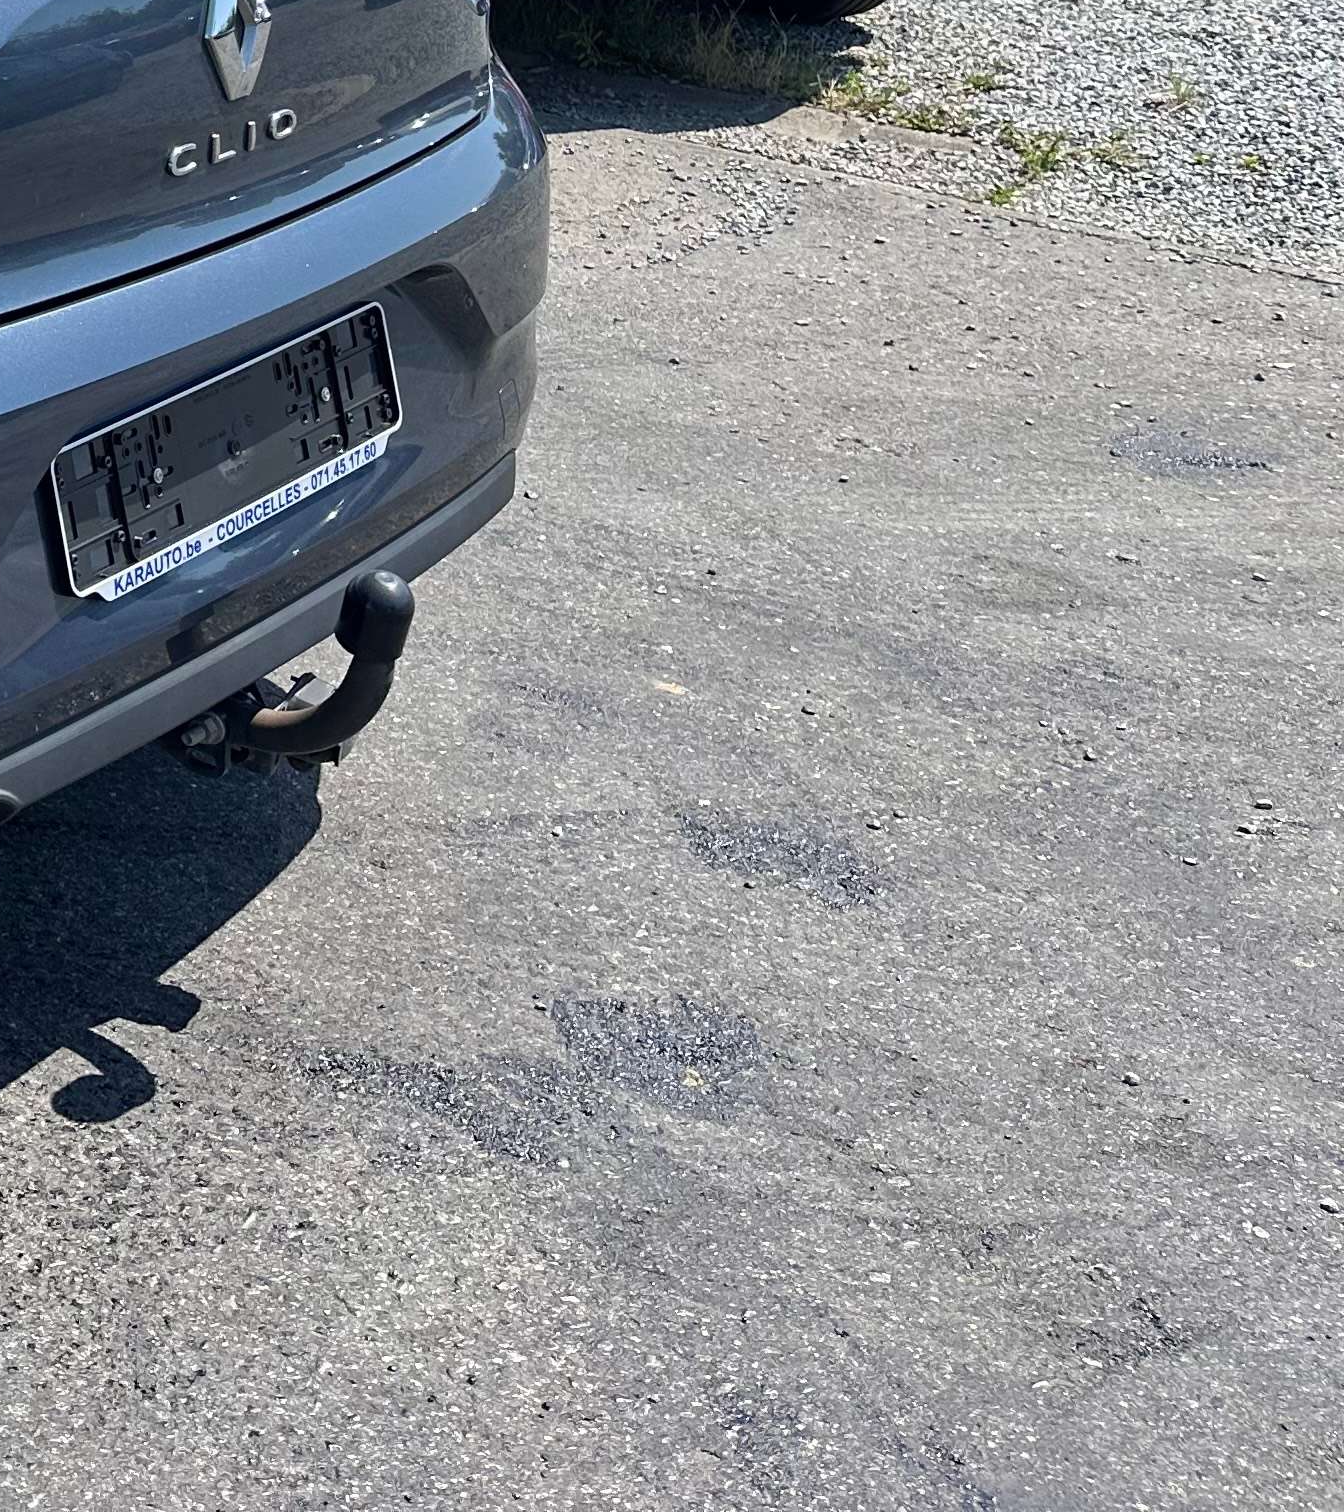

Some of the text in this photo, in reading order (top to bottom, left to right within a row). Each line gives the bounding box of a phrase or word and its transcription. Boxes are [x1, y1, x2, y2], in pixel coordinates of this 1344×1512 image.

[168, 108, 297, 176] CLIO
[114, 539, 202, 596] KARAUTO.be
[216, 482, 301, 541] COURCELLES
[311, 441, 377, 490] 071.45.17.60
